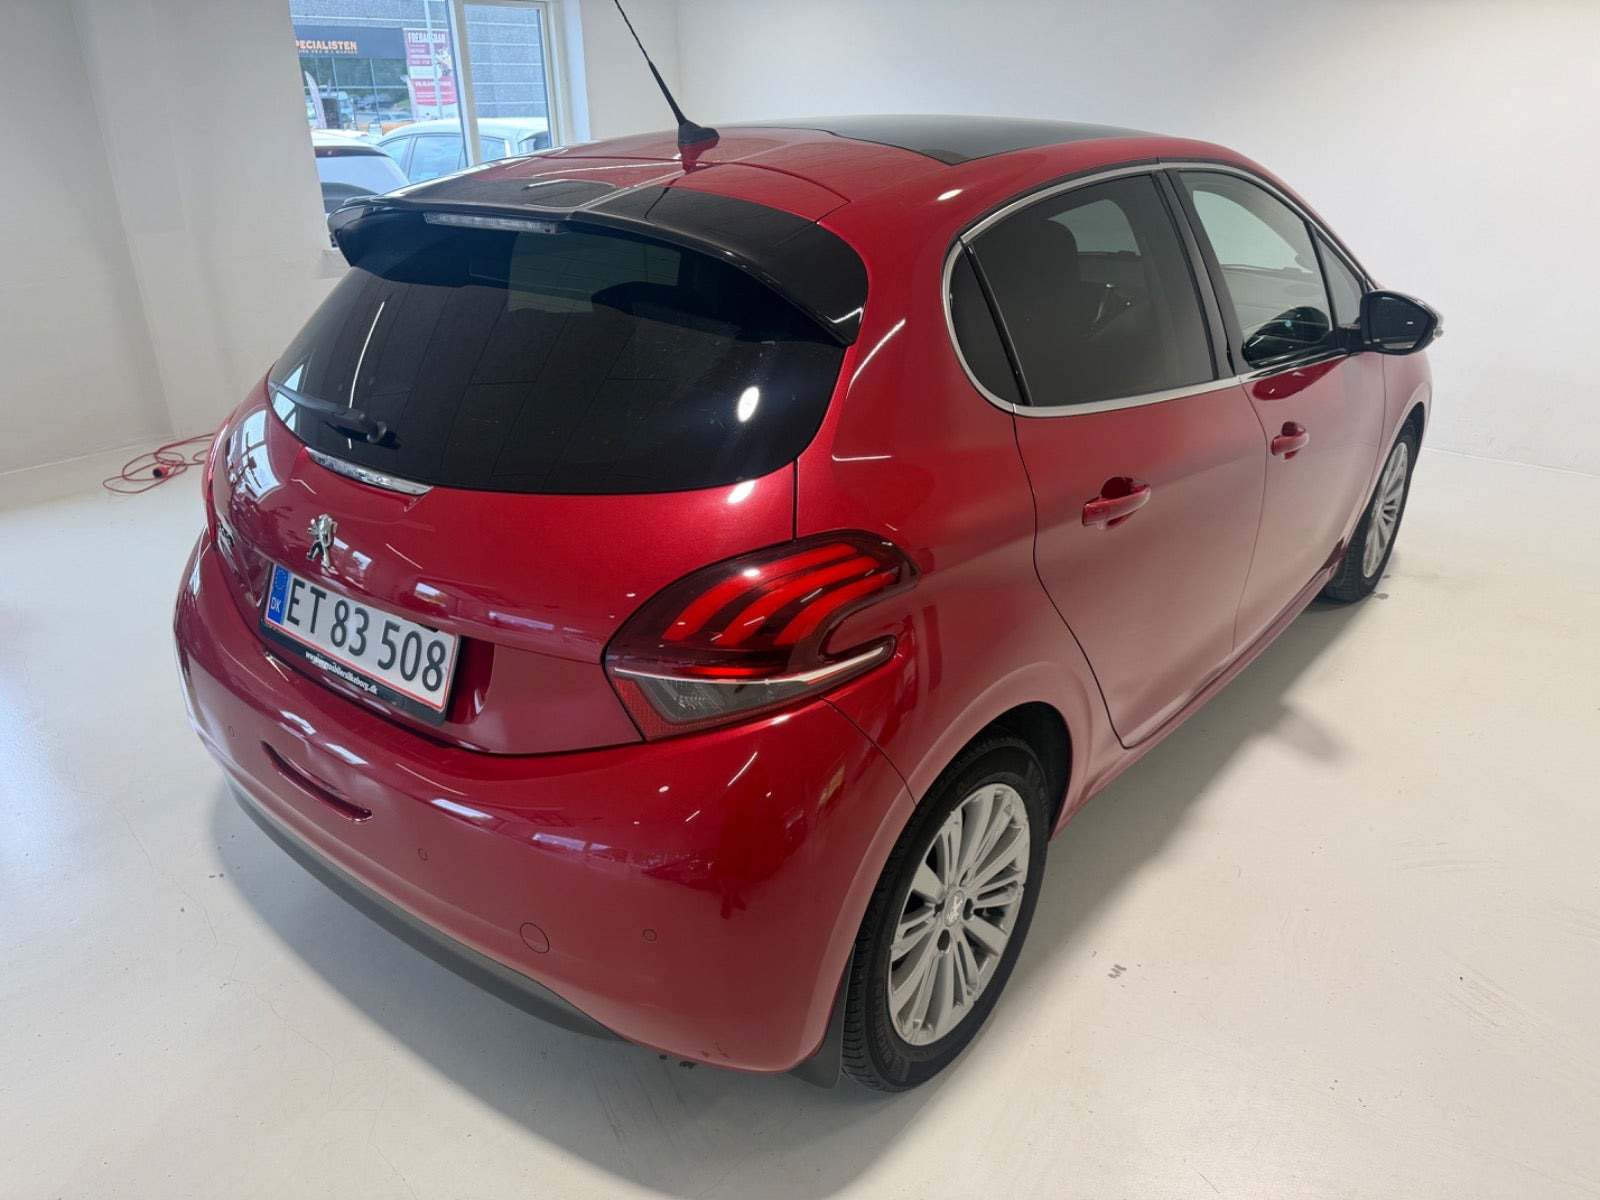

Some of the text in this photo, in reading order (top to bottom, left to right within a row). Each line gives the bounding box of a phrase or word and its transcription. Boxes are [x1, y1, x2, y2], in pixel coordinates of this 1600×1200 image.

[408, 32, 446, 44] FREDABAR
[270, 597, 281, 614] DK
[286, 578, 446, 692] ET 83 508
